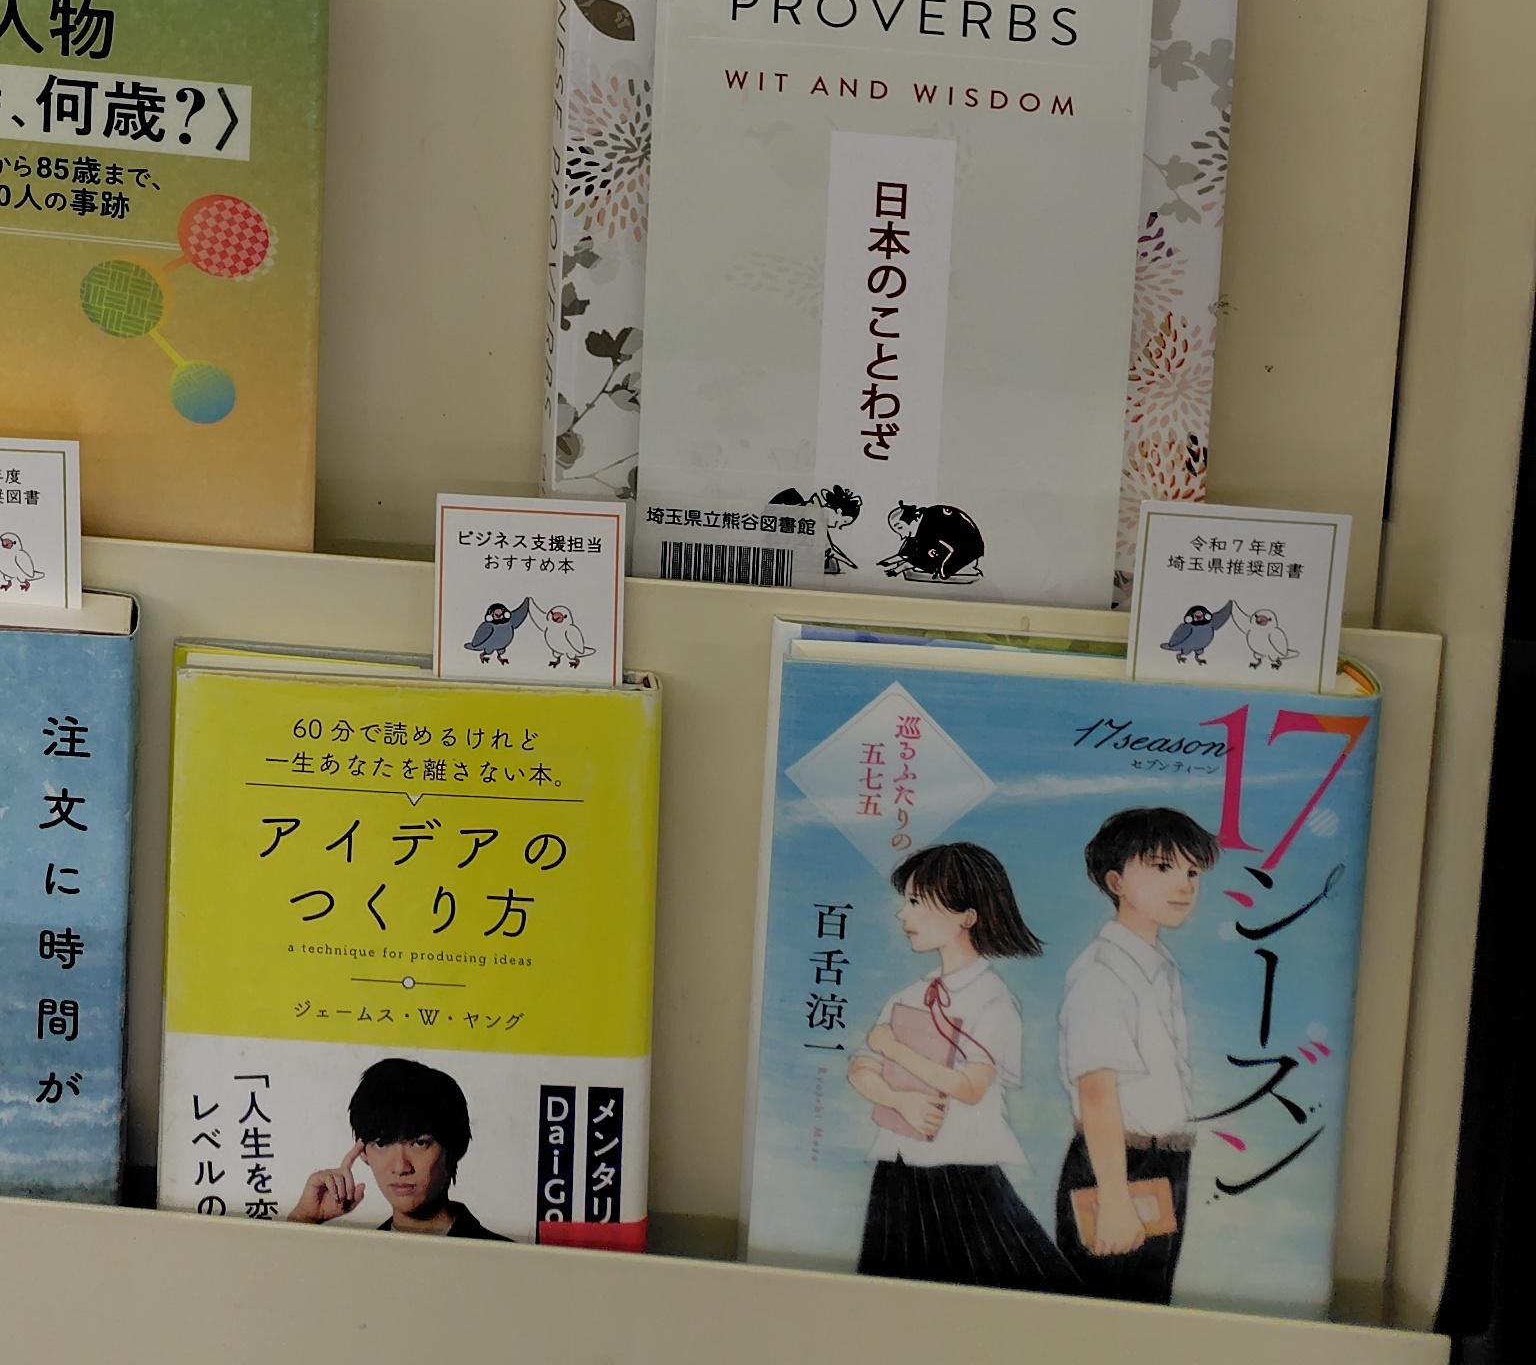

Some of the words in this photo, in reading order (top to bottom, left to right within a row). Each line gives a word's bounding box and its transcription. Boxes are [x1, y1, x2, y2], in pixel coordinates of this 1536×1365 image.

[724, 69, 788, 94] WIT
[810, 76, 889, 100] AND
[913, 82, 1076, 117] WISDOM
[858, 180, 912, 463] 日本のことわざ
[457, 530, 602, 554] ビジネス支援担当
[645, 505, 817, 536] 埼玉県立熊谷図書館
[483, 554, 575, 574] おすすめ本
[1167, 554, 1305, 580] 埼玉県推奨図書
[1188, 533, 1286, 558] 令和7年度
[292, 719, 541, 751] 60分で読めるけれど
[1073, 717, 1235, 759] 17season
[265, 751, 563, 788] 一生あなたを離さない本。
[856, 742, 886, 817] 五七五
[890, 715, 922, 851] 巡るふたりの
[1199, 702, 1371, 871] 17
[259, 817, 567, 871] アイデアの
[35, 715, 92, 1105] 注文に時間が
[289, 883, 536, 939] つくり方
[301, 941, 376, 961] technique
[381, 946, 404, 959] for
[409, 949, 487, 968] producing
[493, 952, 534, 966] ideas
[804, 901, 855, 1056] 百舌涼一
[293, 999, 525, 1031] ジェームス・W・ヤング
[1187, 864, 1346, 1206] シーズン
[192, 1093, 227, 1217] レベルの
